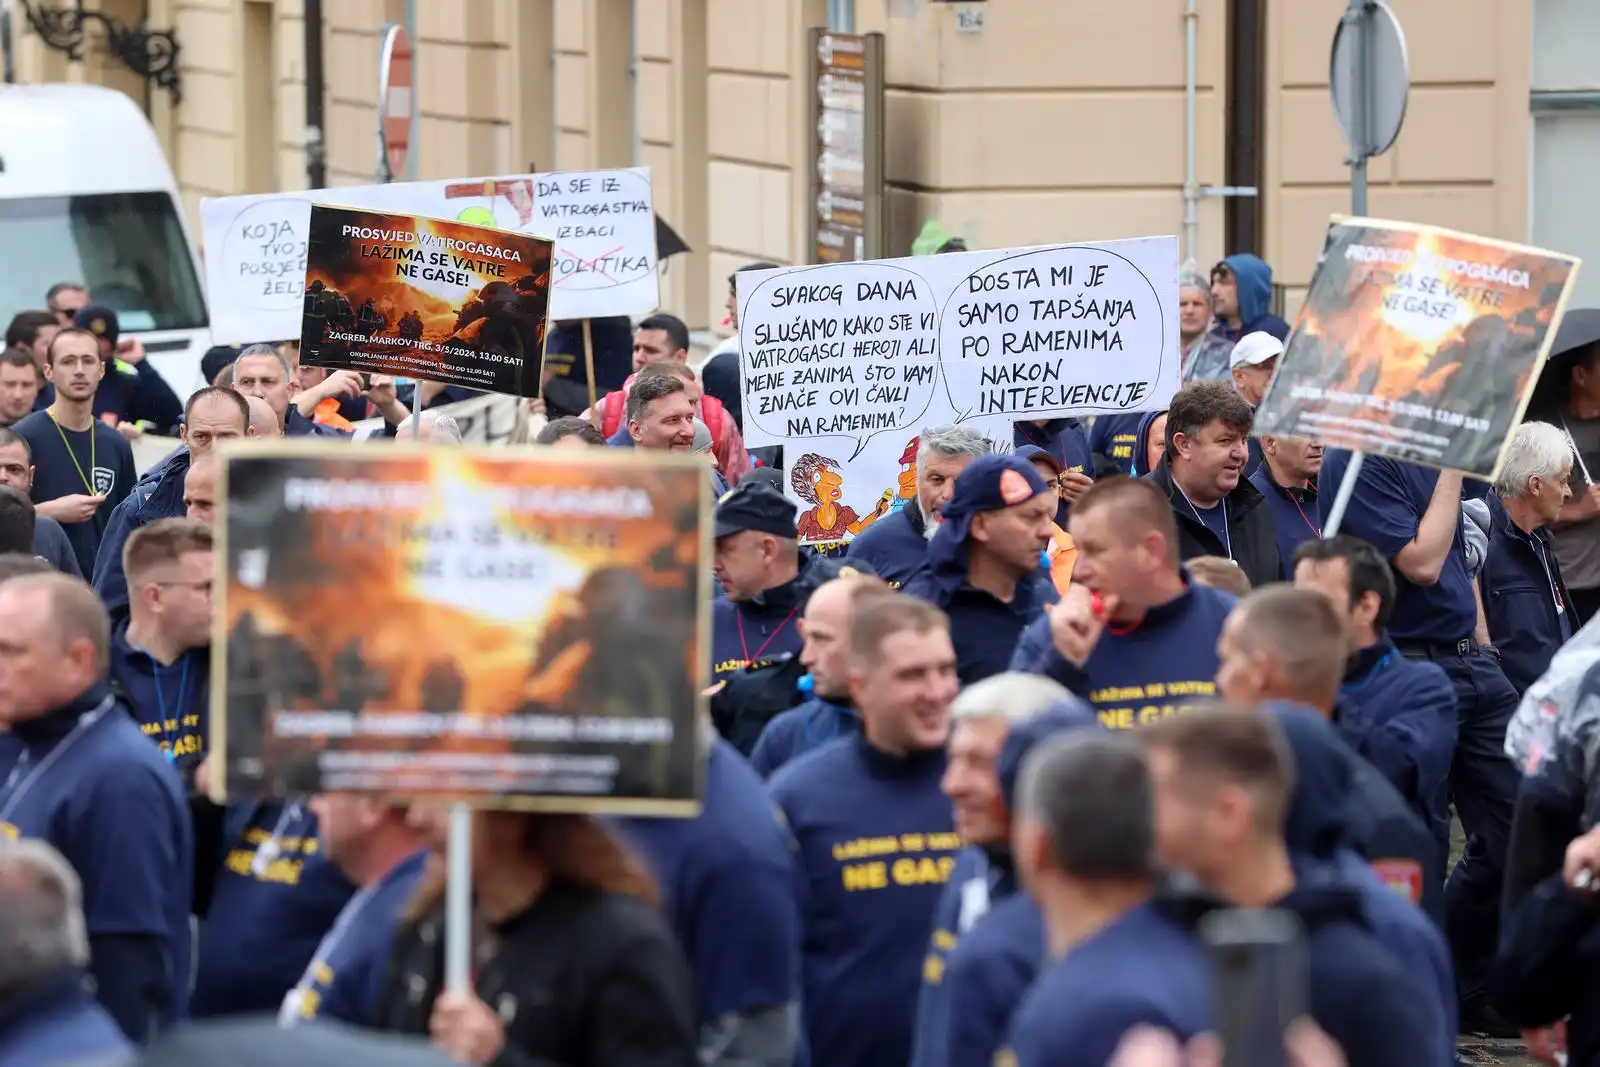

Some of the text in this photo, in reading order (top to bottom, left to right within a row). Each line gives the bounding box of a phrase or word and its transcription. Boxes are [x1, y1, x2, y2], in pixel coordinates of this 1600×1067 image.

[538, 178, 620, 197] DA SE IZ
[541, 201, 648, 217] VATROGASTVA
[242, 220, 294, 243] KOJA
[342, 225, 522, 263] PROSVJED VATROGASACA
[557, 226, 615, 238] IZBACI
[361, 243, 506, 278] LAŽIMA SE VATRE
[396, 262, 470, 287] NE GASE!
[771, 279, 917, 308] SVAKOG DANA
[969, 265, 1108, 293] DOSTA MI JE
[1417, 275, 1440, 295] SE
[958, 293, 1136, 328] SAMO TAPŠANJA
[754, 312, 935, 346] SLUŠAMO KAKO STE VI
[962, 329, 1123, 358] PO RAMENIMA
[328, 330, 368, 343] ZAGREB,
[369, 336, 412, 348] MARKOV
[413, 340, 434, 352] TRG,
[435, 344, 477, 360] 3/5/2024,
[503, 356, 524, 367] SATI
[749, 338, 936, 369] VATROGASCI HEROJI ALI
[349, 351, 389, 360] OKUPLJANJE
[399, 357, 438, 368] EUROPSKOM
[438, 362, 455, 371] TRGU
[482, 370, 496, 378] SATI
[980, 358, 1063, 386] NAKON
[746, 364, 934, 395] MENE ZANIMA ŠTO VAM
[759, 383, 909, 415] ZNAČE OVI ČAVLI
[980, 381, 1148, 413] INTERVENCIJE
[787, 406, 905, 436] NA RAMENIMA?
[1097, 707, 1134, 729] NE
[842, 860, 888, 891] NE
